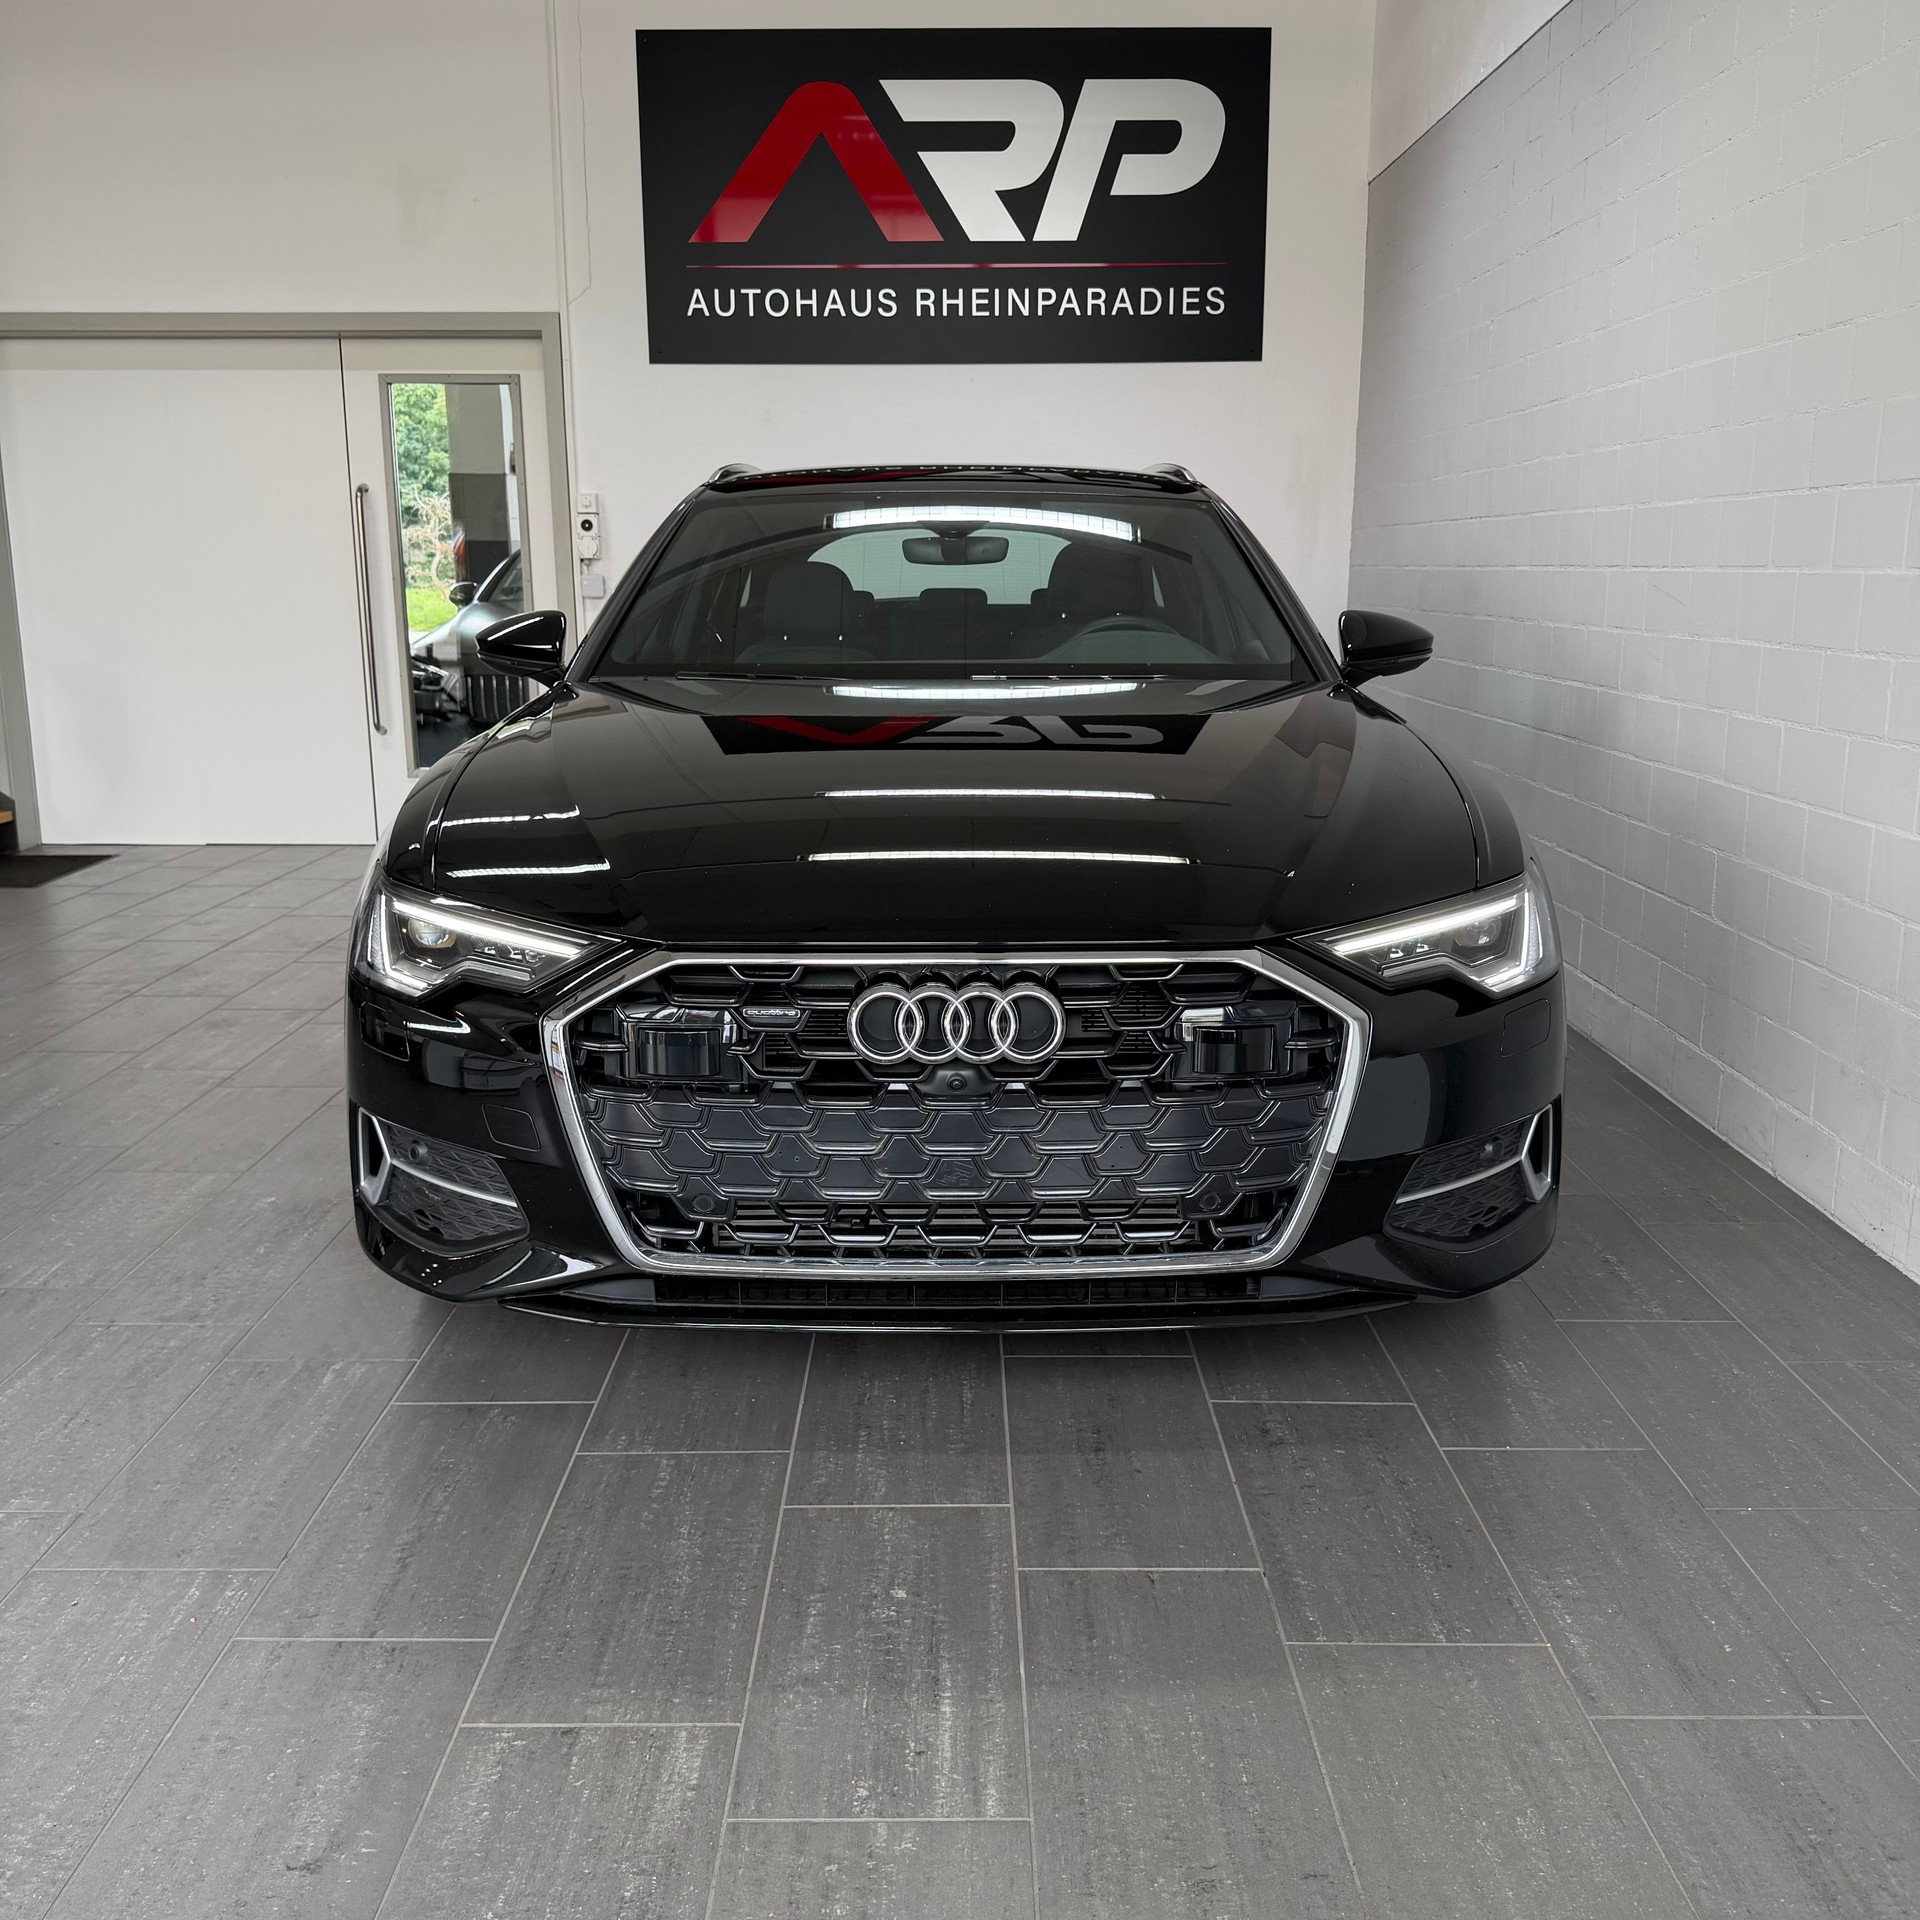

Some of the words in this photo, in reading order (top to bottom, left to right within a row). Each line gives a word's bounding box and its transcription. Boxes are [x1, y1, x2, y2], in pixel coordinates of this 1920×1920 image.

[688, 78, 1225, 243] ARP
[686, 287, 898, 318] AUTOHAUS
[916, 286, 1225, 317] RHEINPARADIES
